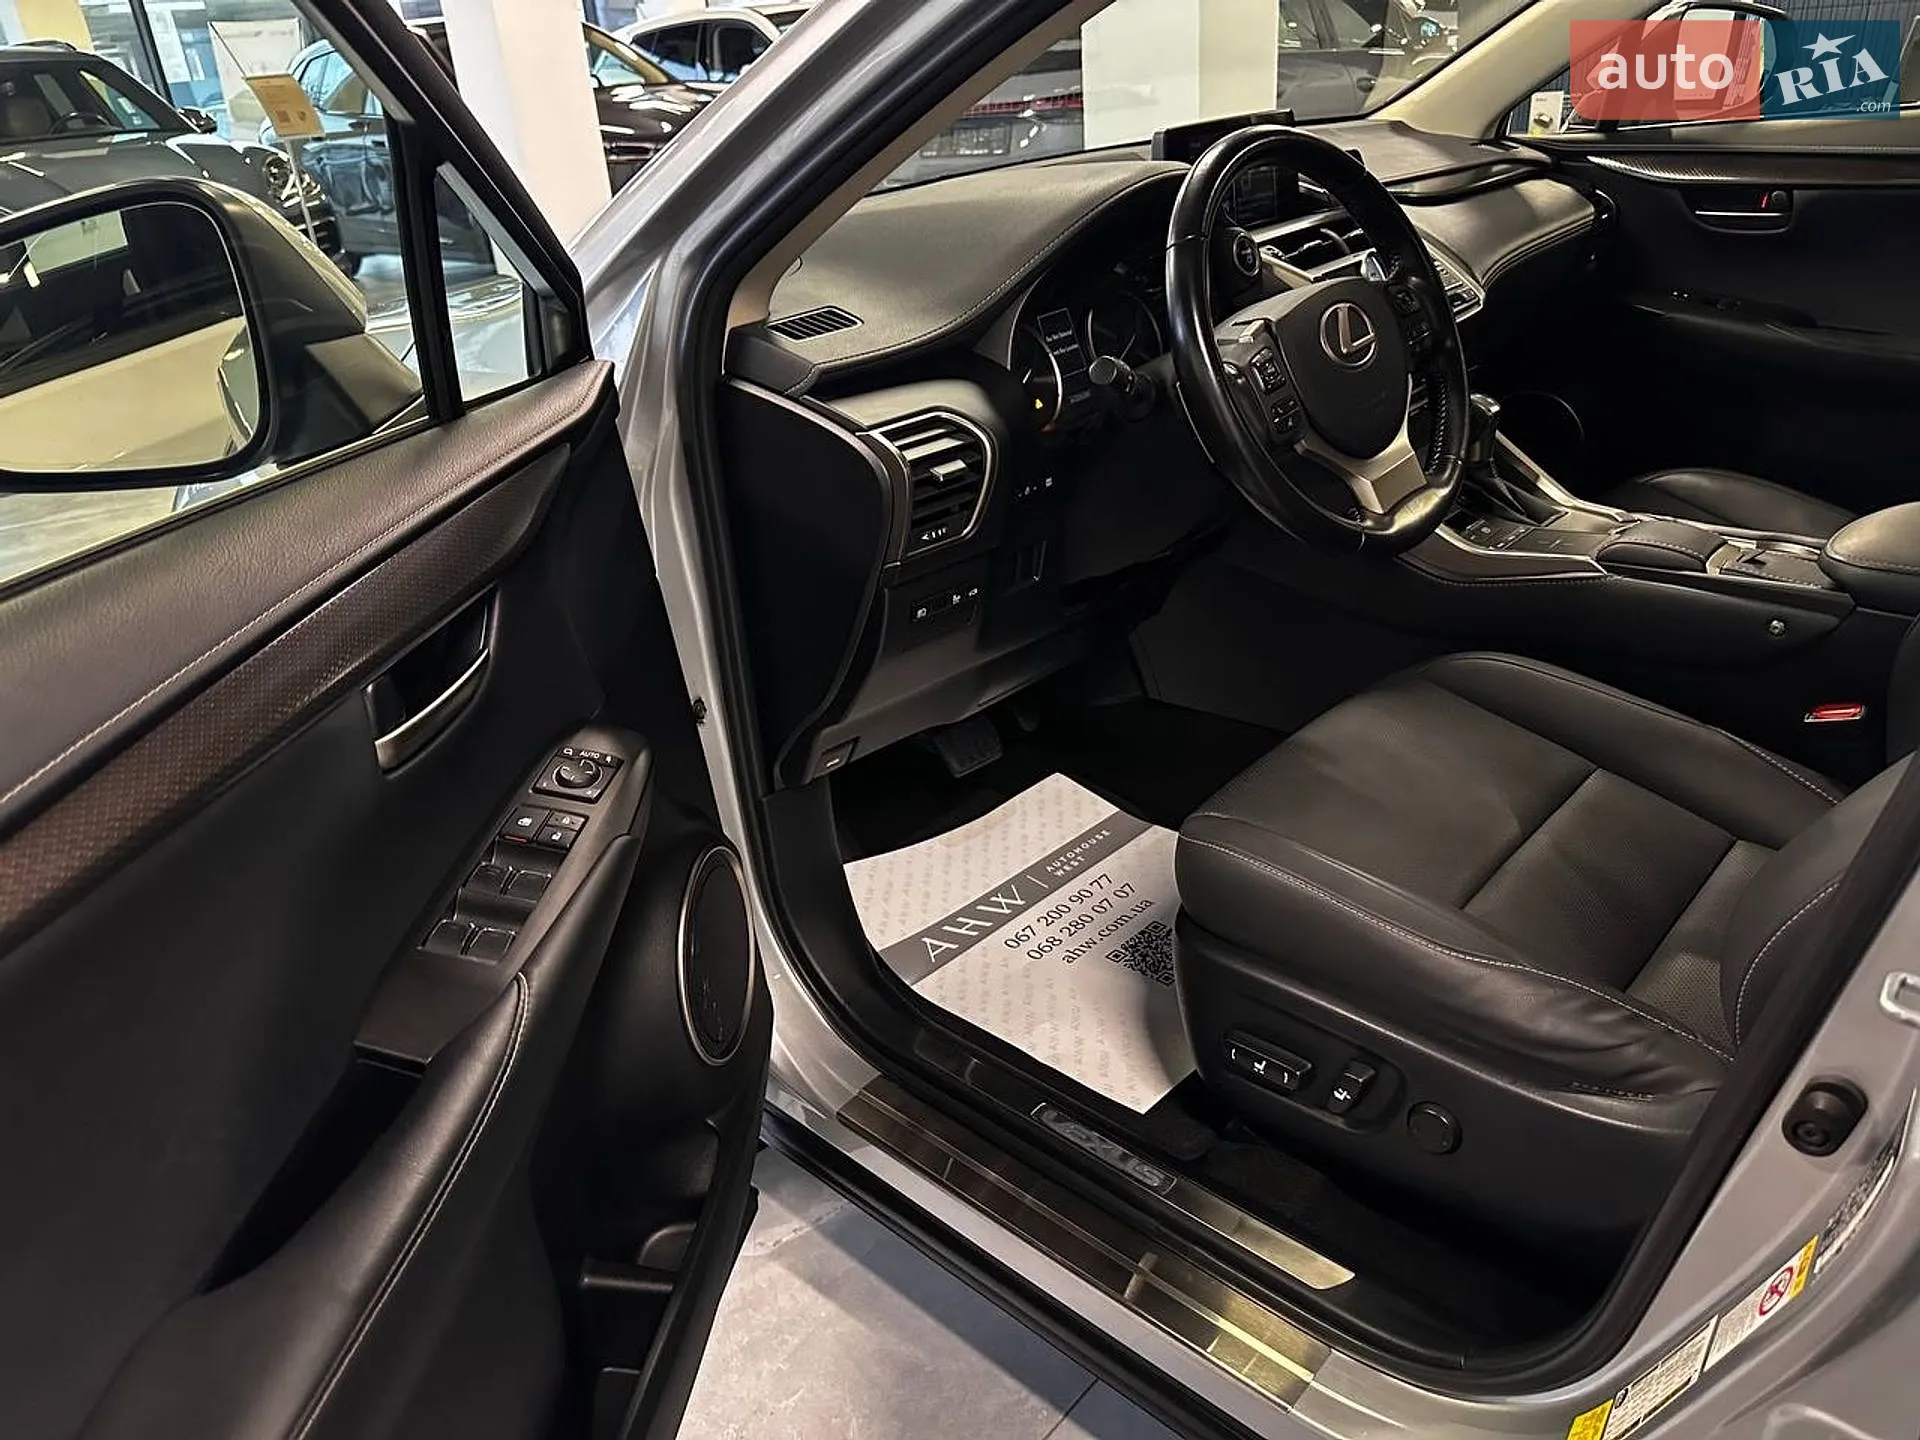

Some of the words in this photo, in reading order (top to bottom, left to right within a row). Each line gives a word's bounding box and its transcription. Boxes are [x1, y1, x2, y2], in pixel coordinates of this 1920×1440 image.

[579, 750, 600, 759] AUTO
[1045, 829, 1111, 873] AUTOHOUSE
[1052, 856, 1086, 877] WEST
[921, 884, 1026, 963] AHW
[1004, 925, 1037, 950] 067
[1038, 904, 1070, 928] 200
[1069, 889, 1093, 905] 90
[1090, 874, 1113, 891] 77
[1027, 935, 1063, 961] 068
[1060, 914, 1094, 938] 280
[1091, 897, 1115, 914] 07
[1114, 882, 1137, 900] 07
[1062, 899, 1155, 965] ahw.com.ua
